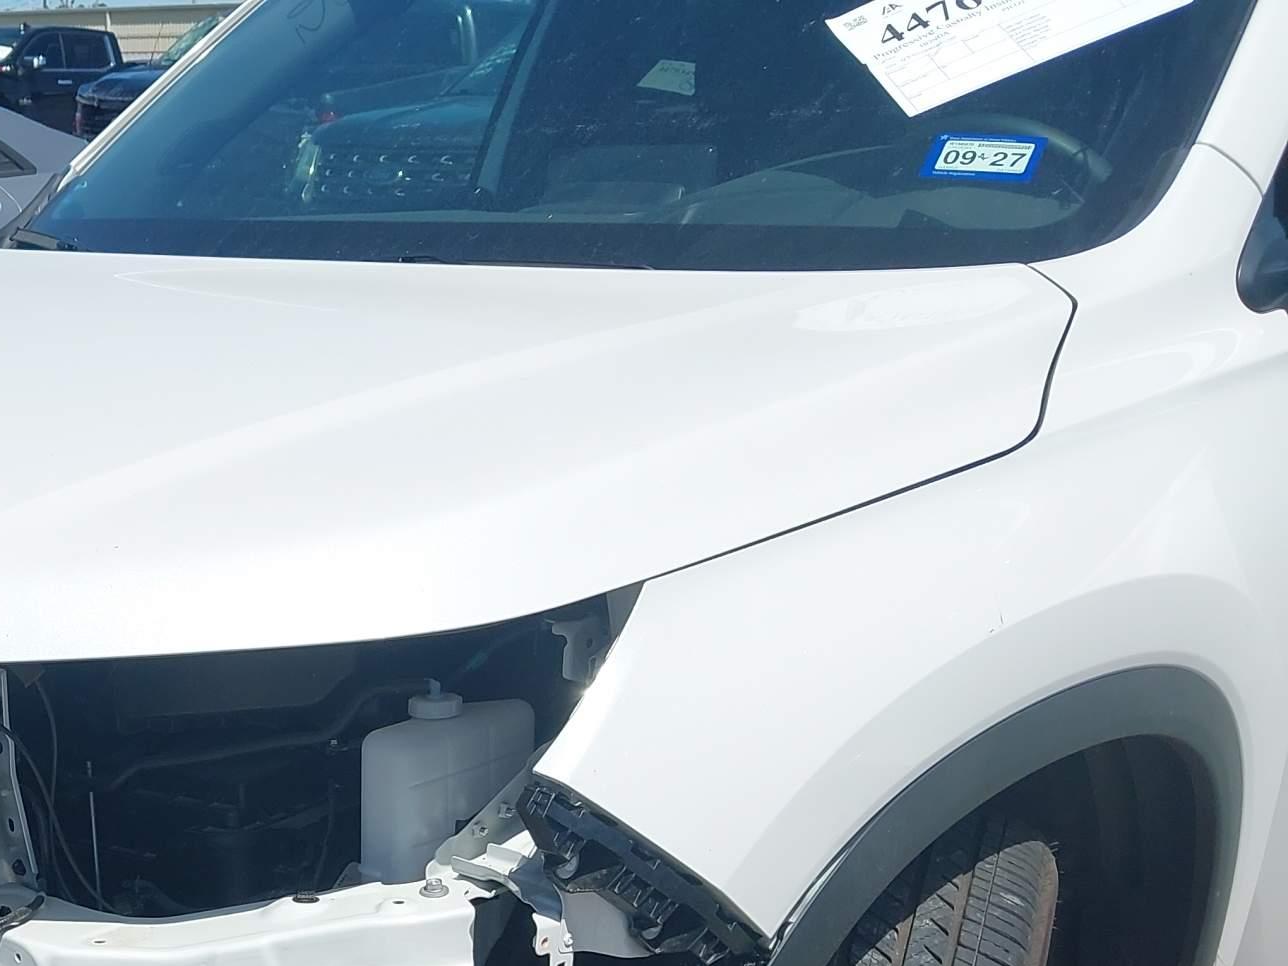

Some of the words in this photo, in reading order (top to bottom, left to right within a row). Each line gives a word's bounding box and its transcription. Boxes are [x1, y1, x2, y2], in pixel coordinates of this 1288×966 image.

[873, 29, 935, 61] Progressive
[943, 149, 977, 166] 09
[989, 151, 1027, 168] 27
